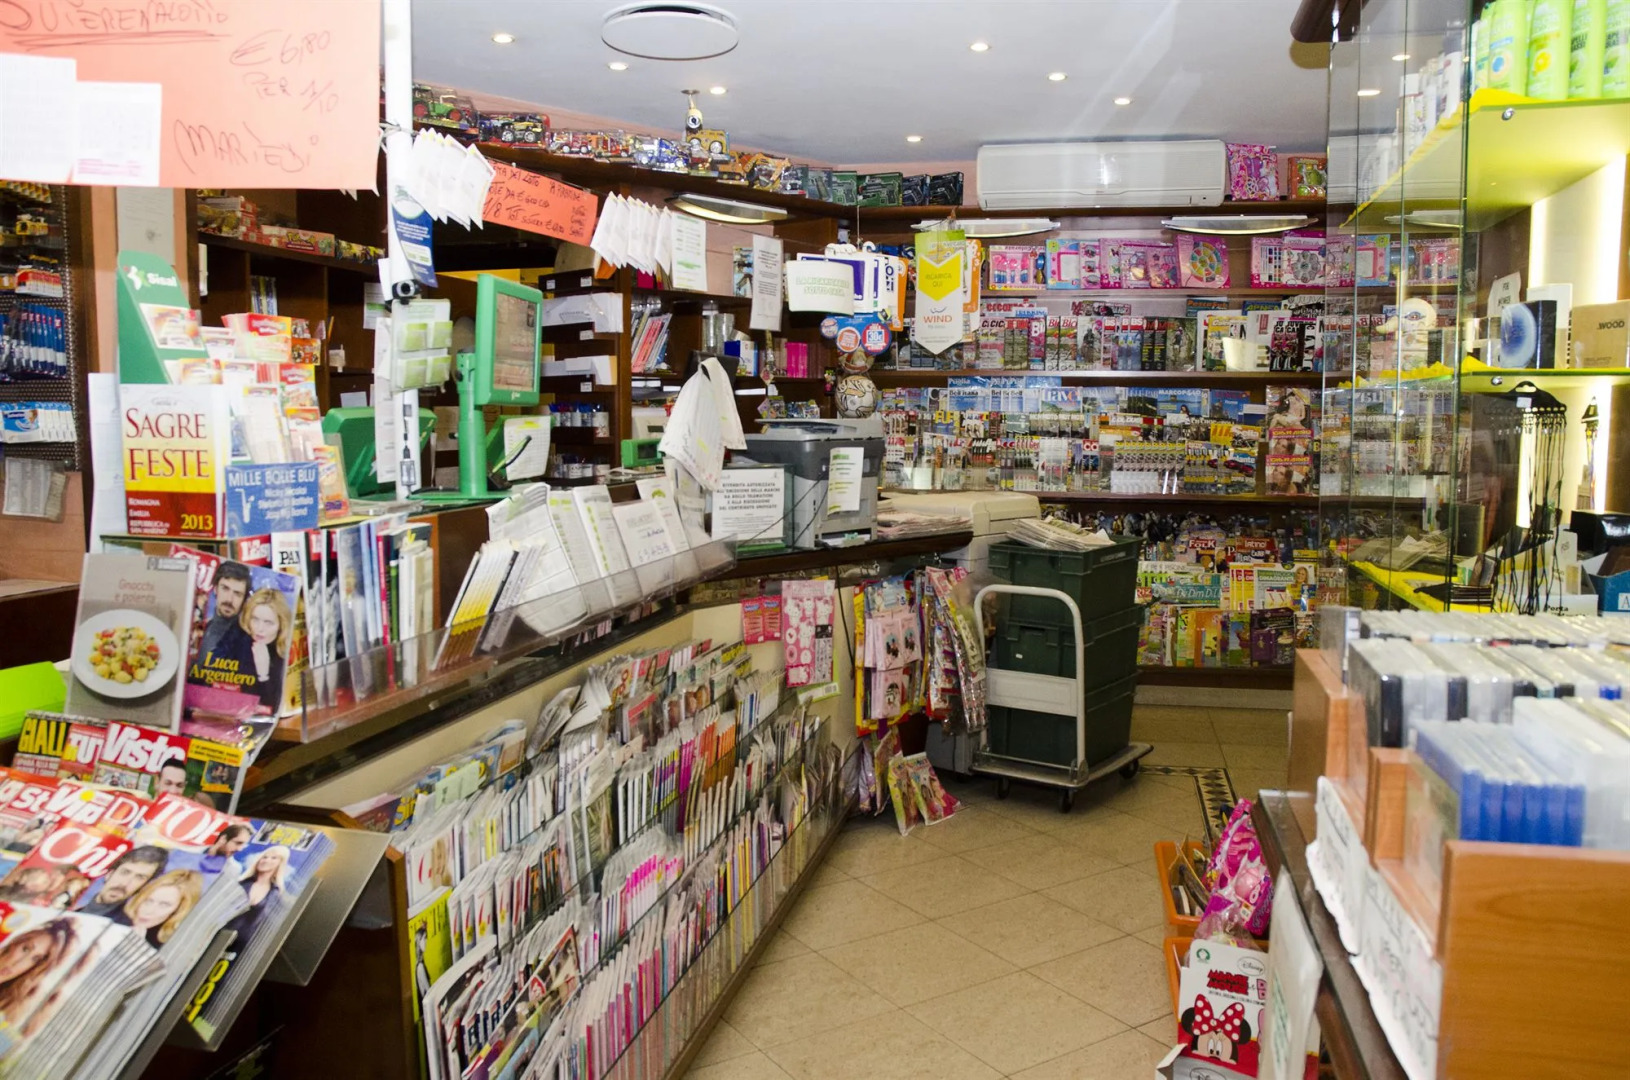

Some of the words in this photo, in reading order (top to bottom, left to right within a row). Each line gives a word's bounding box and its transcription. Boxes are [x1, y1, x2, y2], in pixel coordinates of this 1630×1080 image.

[147, 272, 178, 288] Sisal
[923, 314, 953, 324] WIND
[126, 407, 207, 438] SAGRE
[128, 448, 210, 481] FESTE
[228, 470, 262, 488] MILLE
[265, 469, 297, 486] BOLLE
[297, 468, 316, 483] BLU
[128, 497, 161, 507] ROMAGNA
[128, 509, 151, 518] EMILIA
[179, 513, 214, 531] 2013
[129, 519, 165, 528] REPUBBLICA
[143, 527, 168, 535] MARINO
[203, 651, 240, 672] Luca
[188, 663, 256, 687] Argentero
[39, 827, 129, 878] Chi
